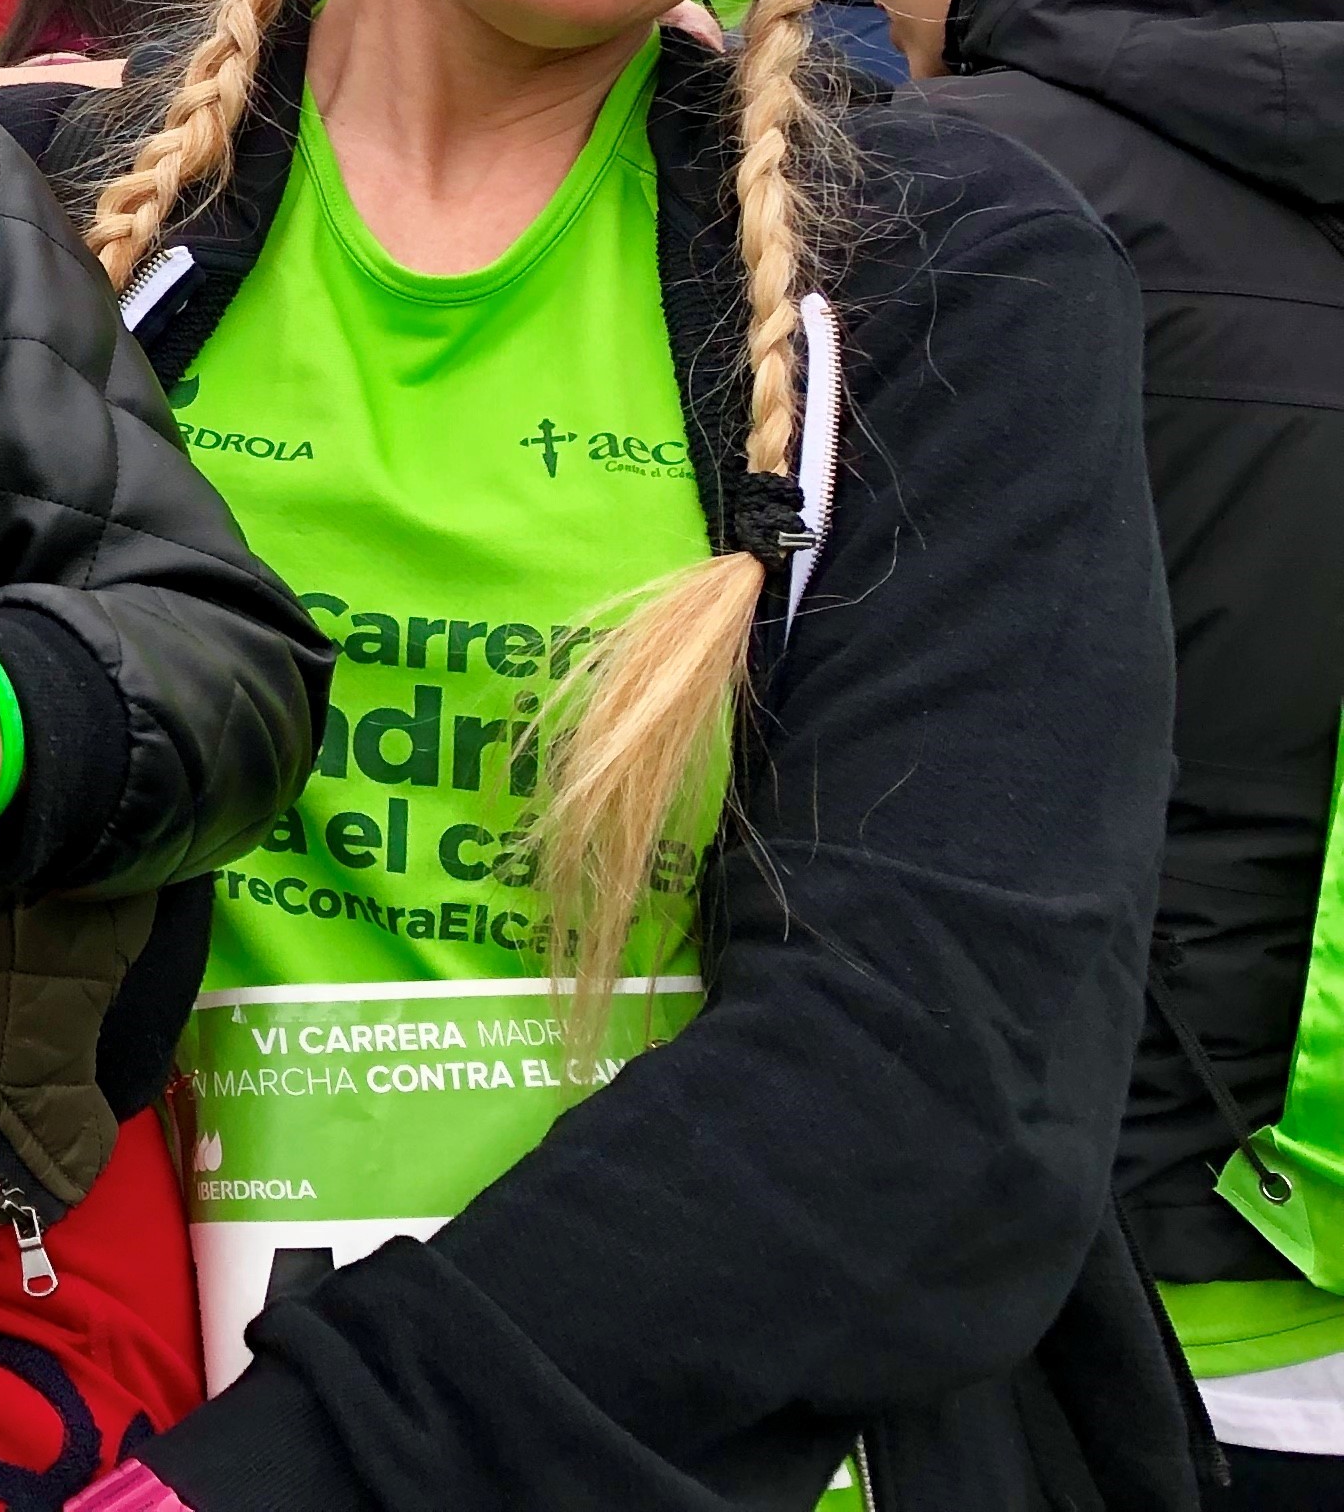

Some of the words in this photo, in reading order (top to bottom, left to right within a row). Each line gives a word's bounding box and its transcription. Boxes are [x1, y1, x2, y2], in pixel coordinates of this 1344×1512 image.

[605, 460, 647, 476] Contra
[650, 467, 662, 478] el
[324, 797, 409, 874] el
[250, 1027, 288, 1055] VI
[297, 1021, 467, 1054] CARRERA
[213, 1065, 359, 1098] MARCHA
[365, 1061, 515, 1094] CONTRA
[521, 1059, 562, 1088] EL
[196, 1178, 318, 1202] IBERDROLA
